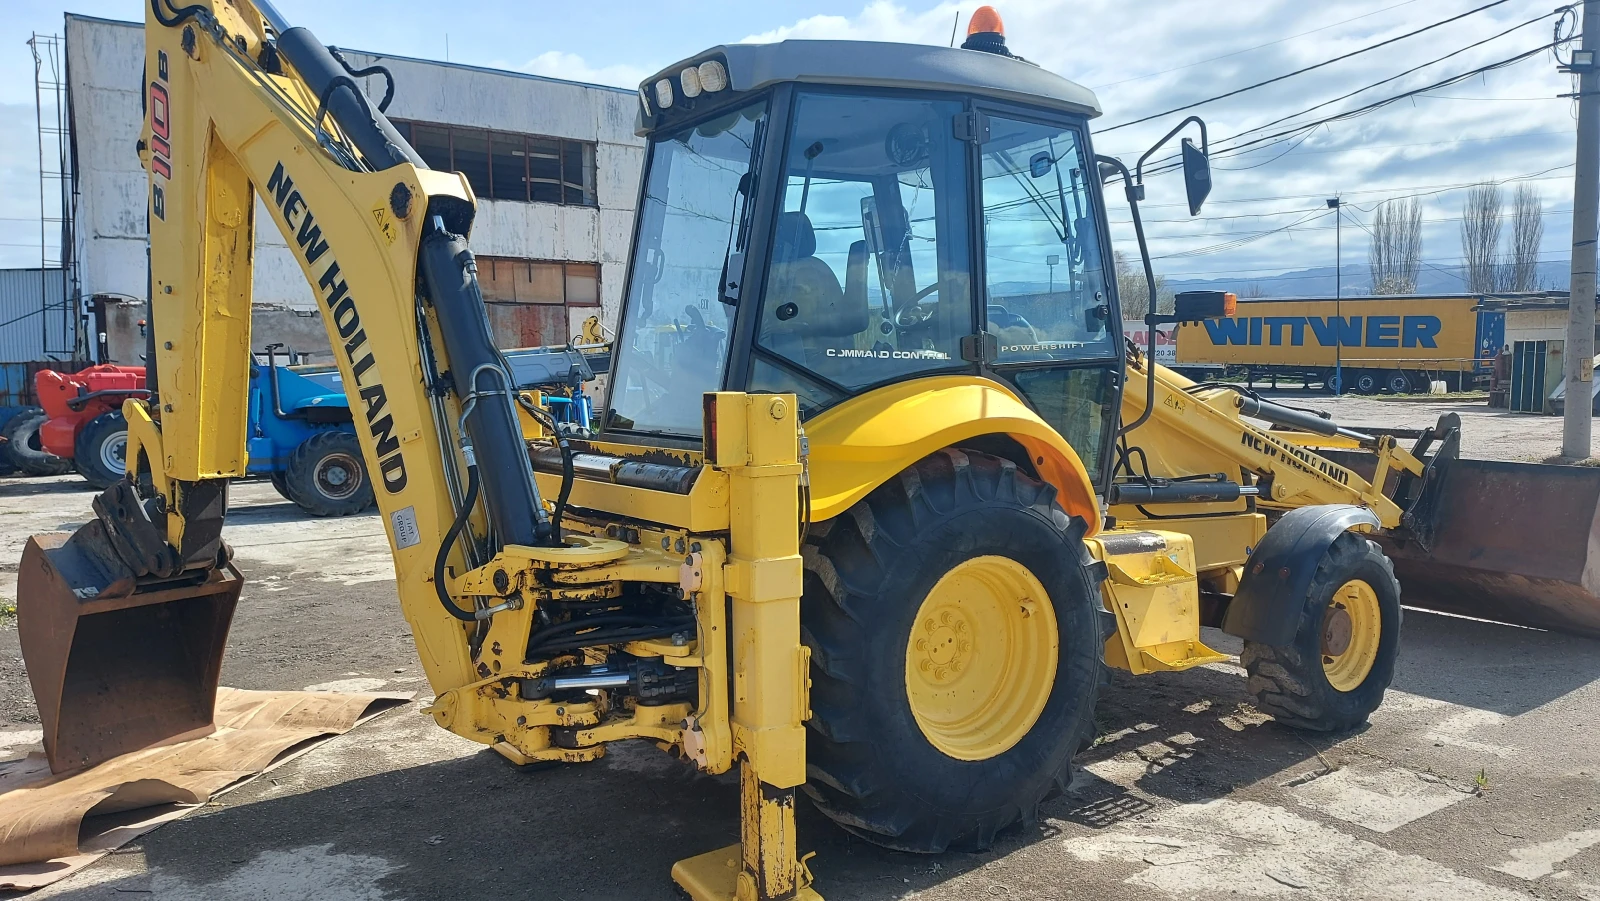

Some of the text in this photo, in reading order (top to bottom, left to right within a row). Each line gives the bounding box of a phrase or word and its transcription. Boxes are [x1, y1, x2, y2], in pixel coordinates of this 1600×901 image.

[266, 160, 408, 495] NEW HOLLAND
[1203, 316, 1441, 348] WITTWER
[893, 350, 951, 360] CONTROL
[1001, 342, 1085, 352] POWERSHIFT
[396, 514, 408, 543] GROUP
